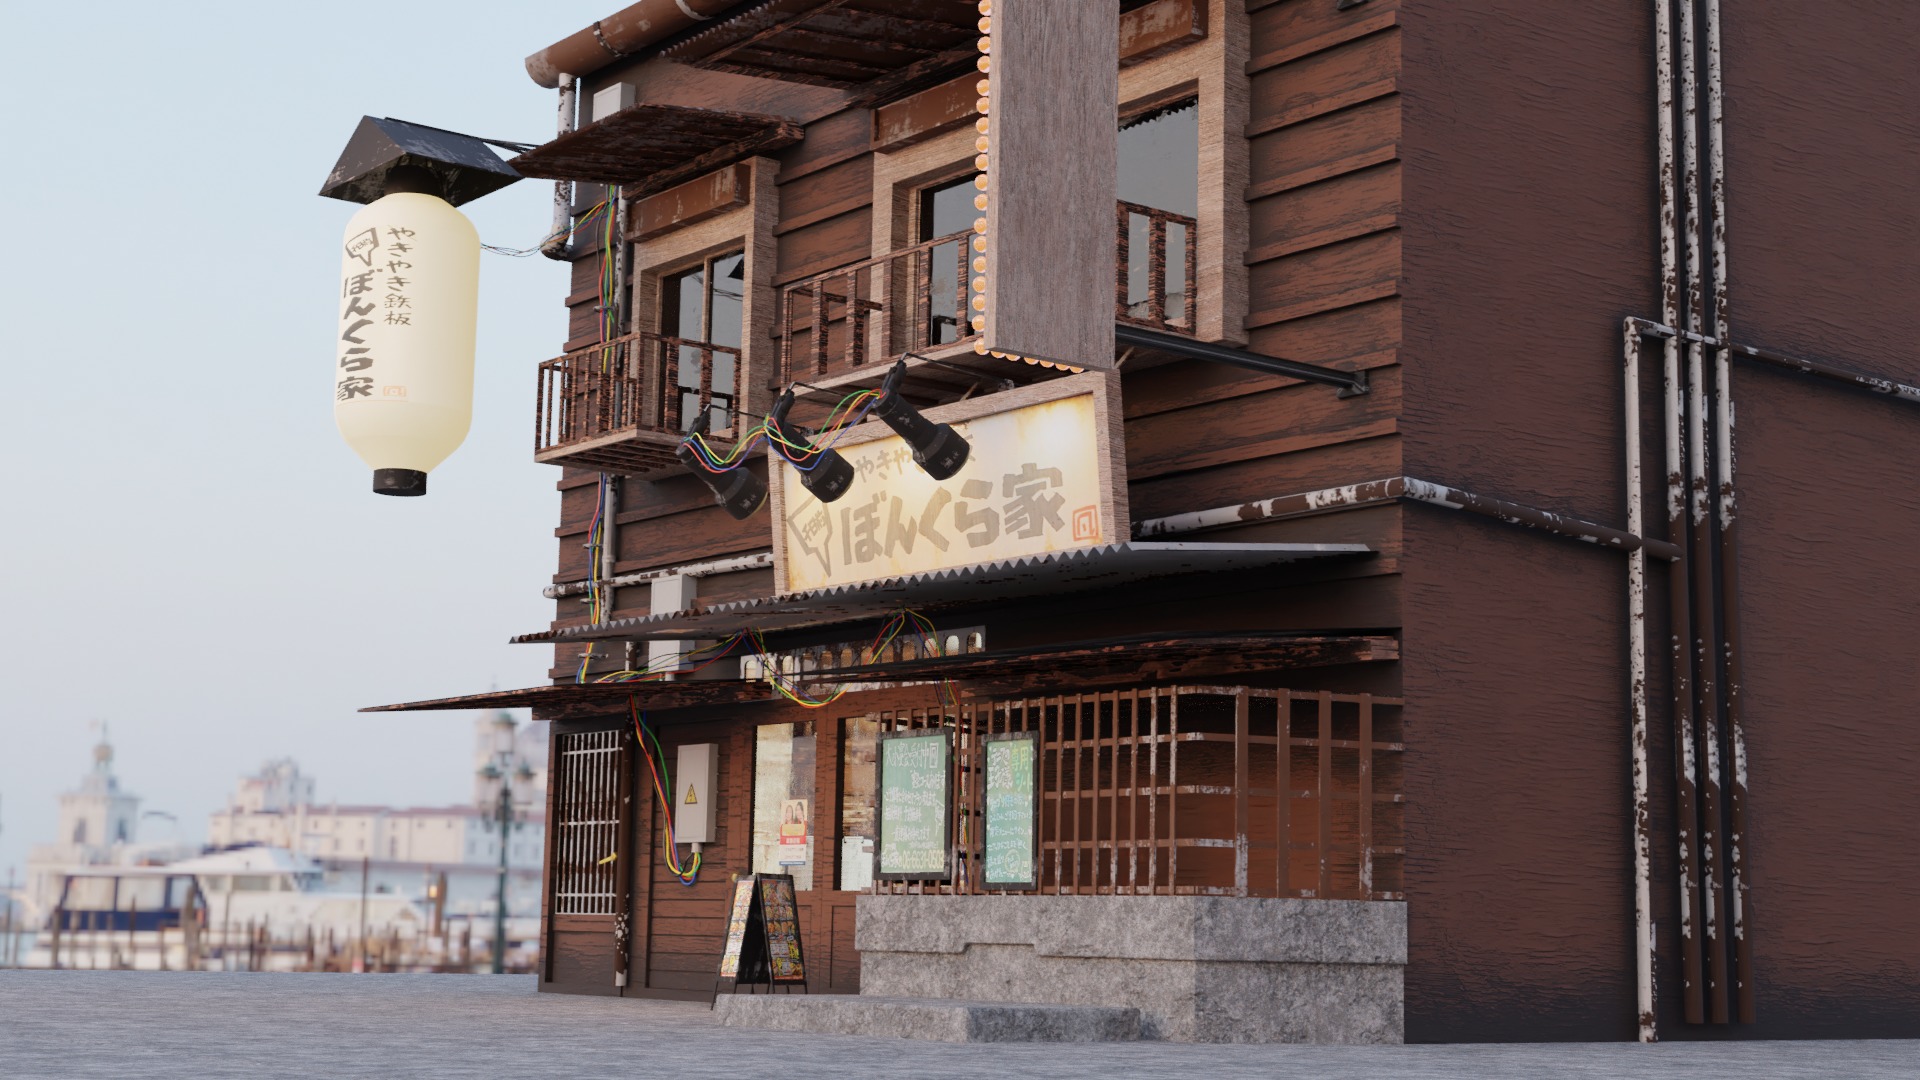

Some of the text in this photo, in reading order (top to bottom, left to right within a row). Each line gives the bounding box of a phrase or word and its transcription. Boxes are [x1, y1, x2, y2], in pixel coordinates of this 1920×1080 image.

[383, 226, 417, 326] やきやき鉄板
[337, 270, 384, 400] ぼんくら家
[840, 462, 1066, 566] ぼんくら家
